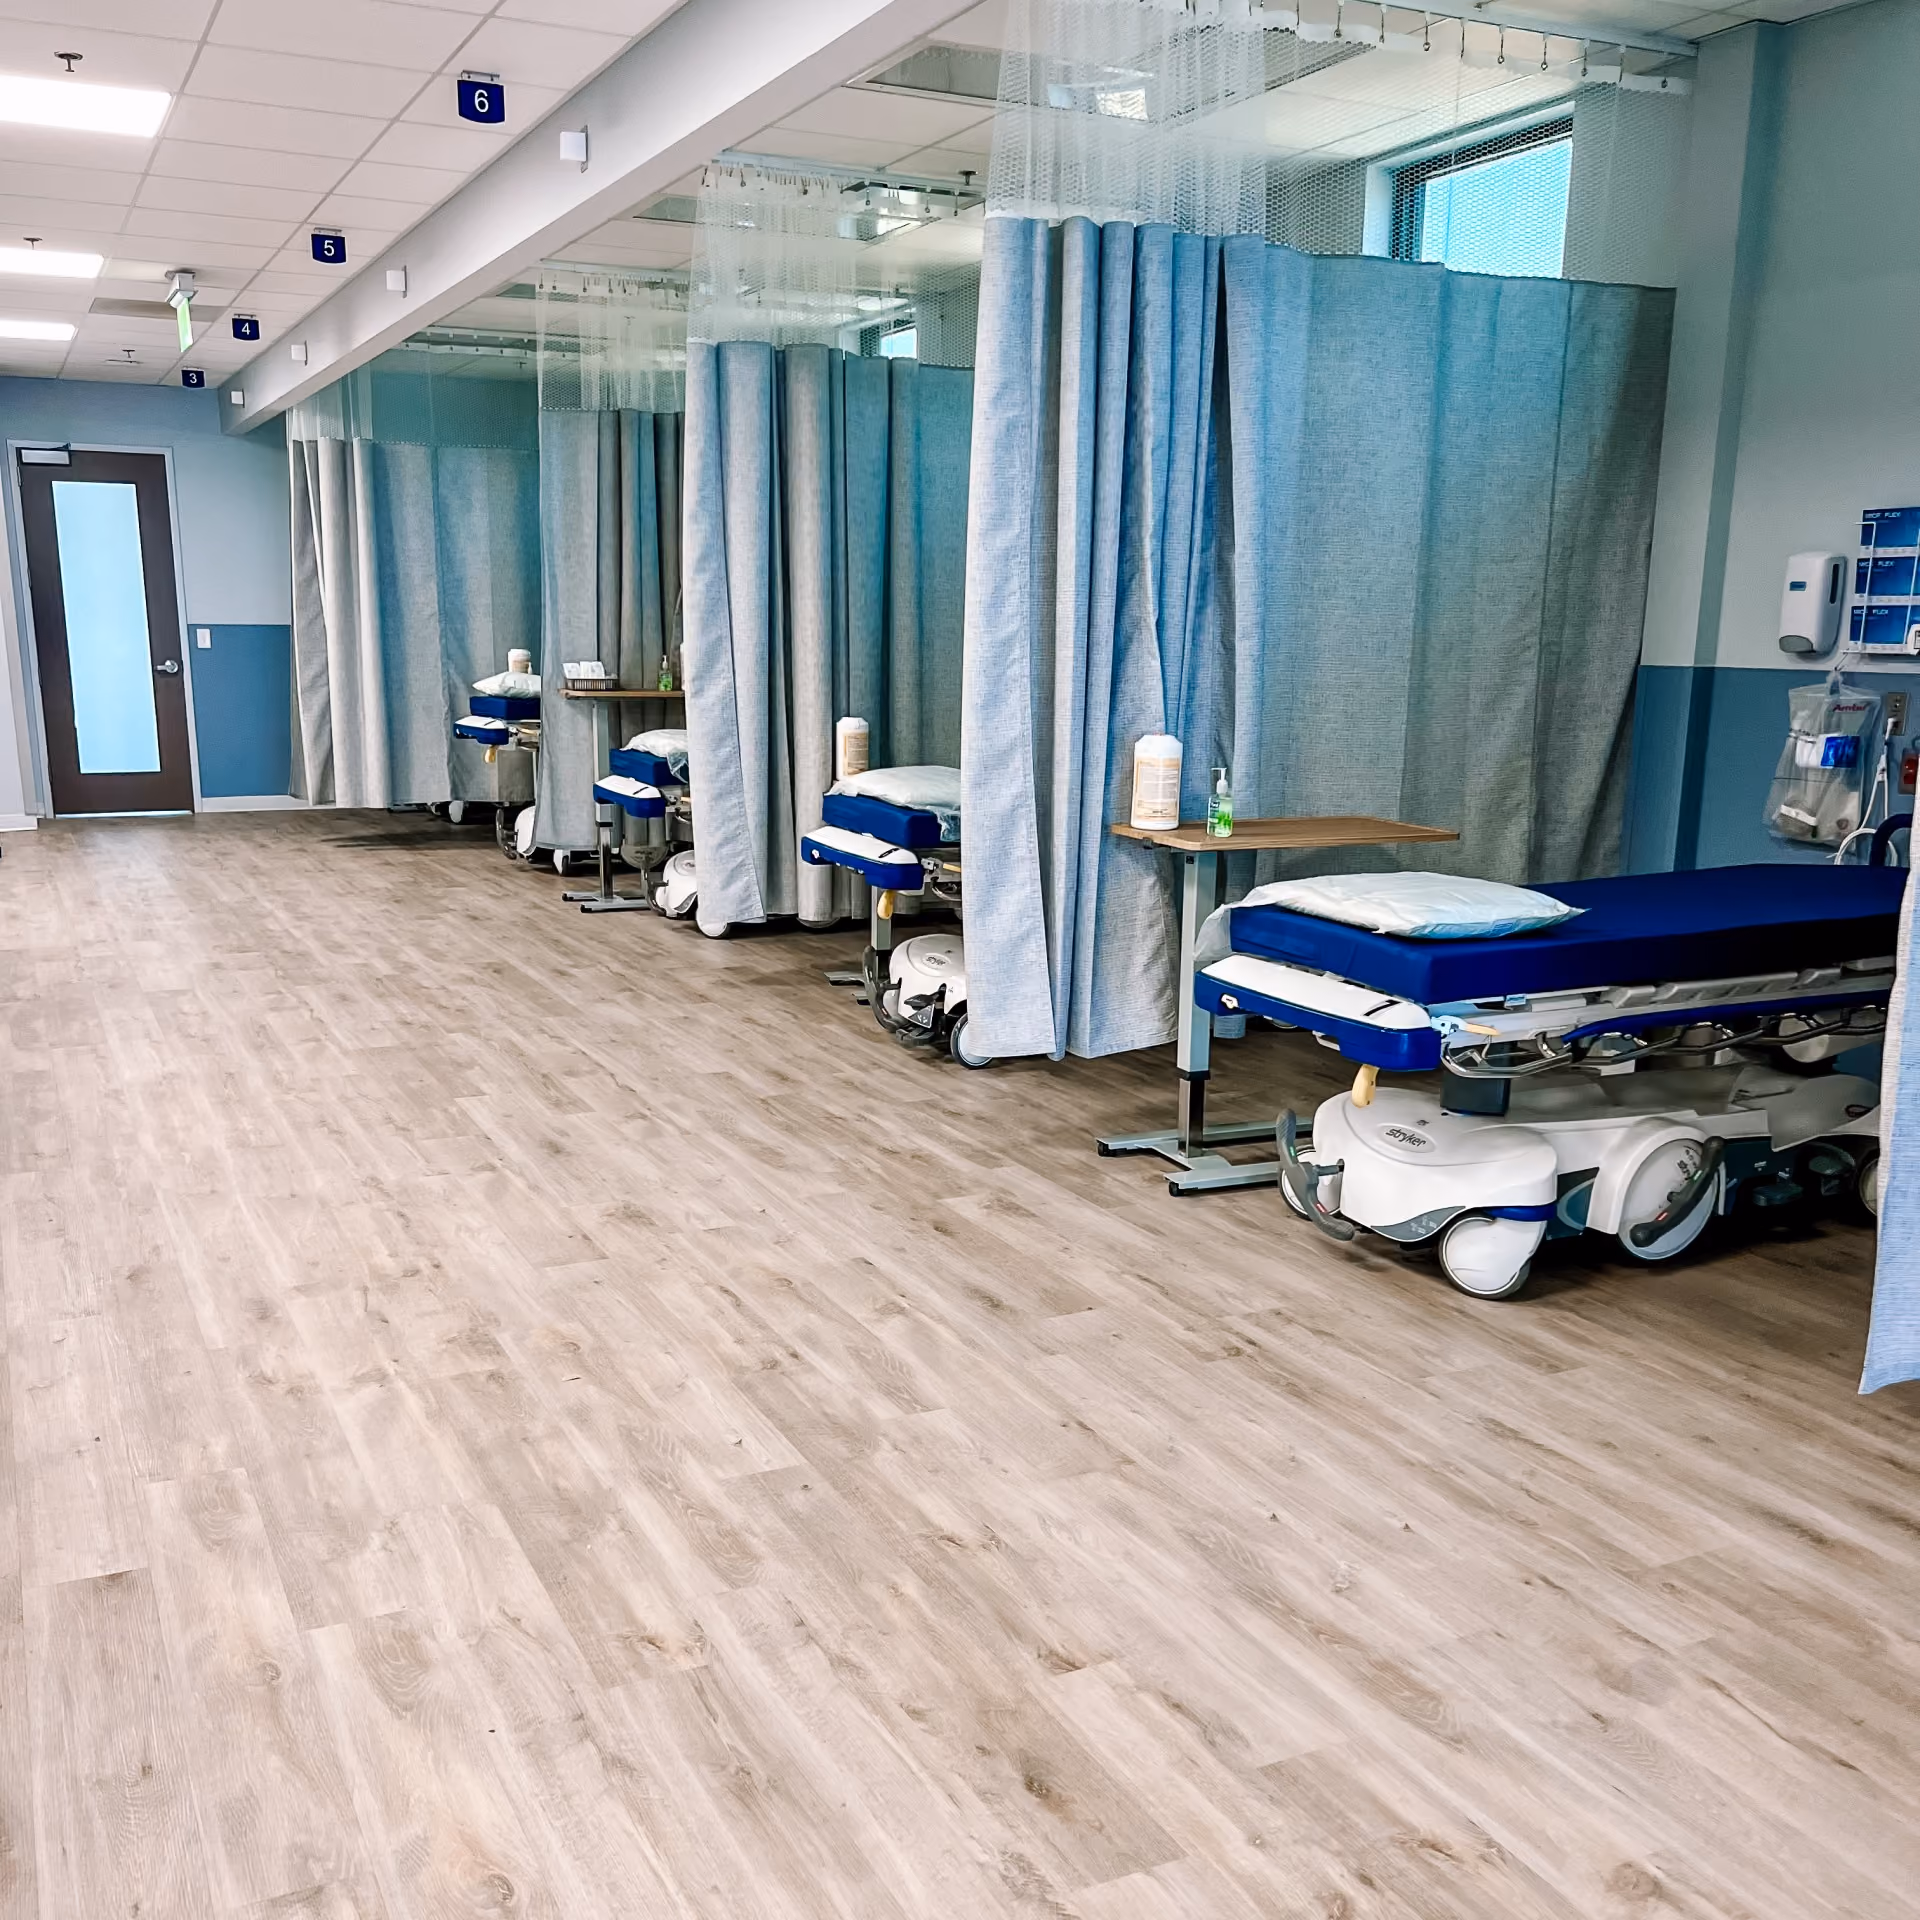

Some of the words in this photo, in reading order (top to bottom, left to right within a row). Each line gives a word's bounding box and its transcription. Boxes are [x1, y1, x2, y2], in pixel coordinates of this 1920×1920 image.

[475, 89, 489, 113] 6
[324, 240, 335, 257] 5
[241, 322, 251, 336] 4
[189, 372, 198, 384] 3
[1385, 1128, 1427, 1147] stryker
